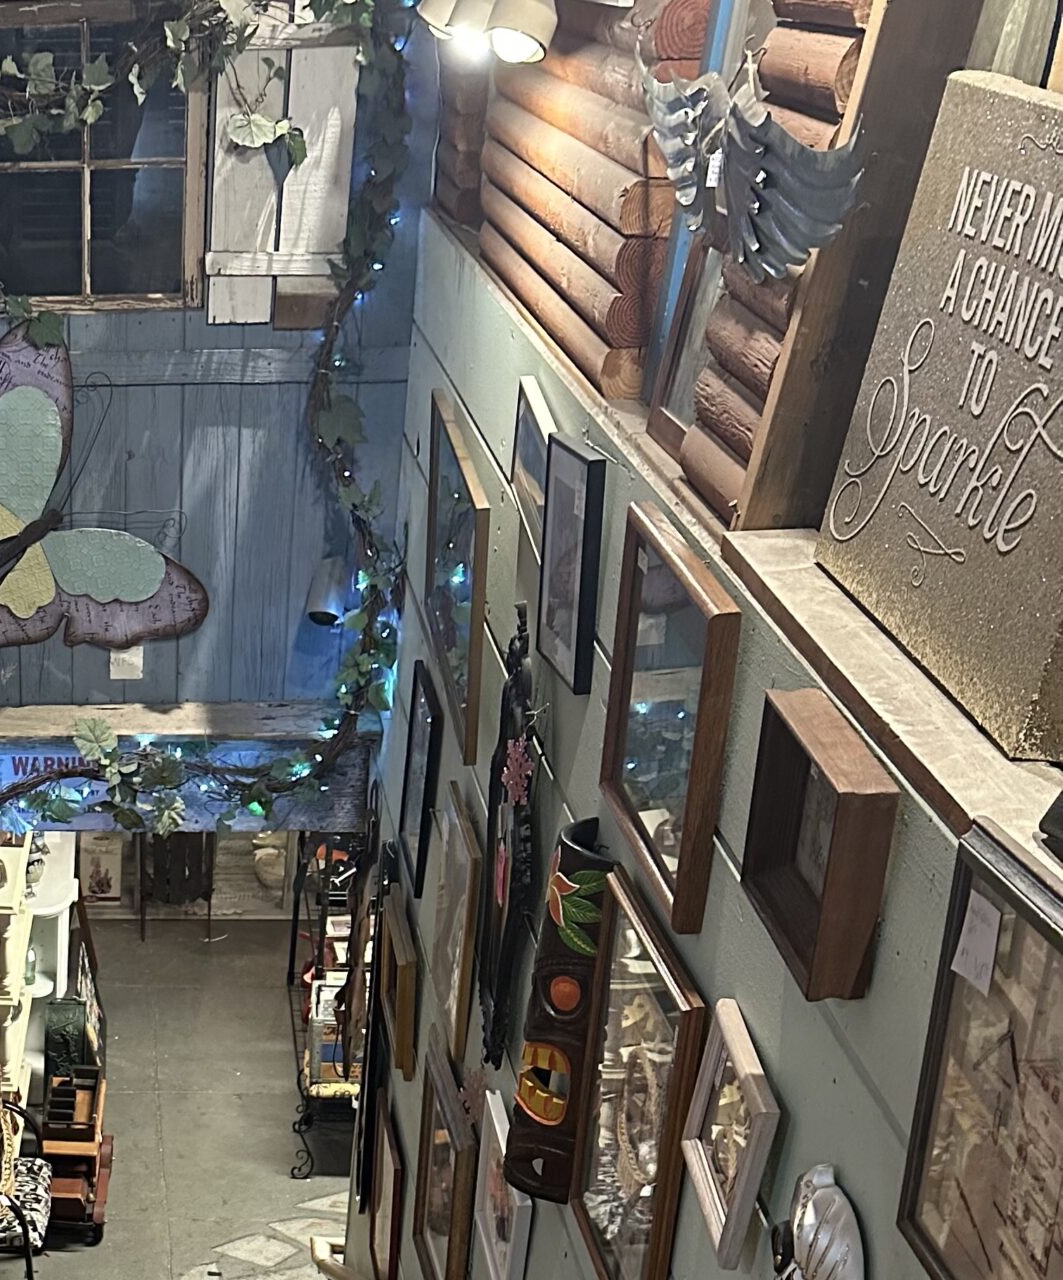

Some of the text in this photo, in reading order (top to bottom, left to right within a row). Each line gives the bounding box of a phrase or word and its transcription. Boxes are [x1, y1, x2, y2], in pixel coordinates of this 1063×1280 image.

[947, 167, 1063, 282] NEVER MI
[939, 249, 1063, 370] A CHANCE
[830, 318, 1063, 553] Sparkle
[958, 341, 998, 416] TO
[11, 756, 98, 777] WARNIN
